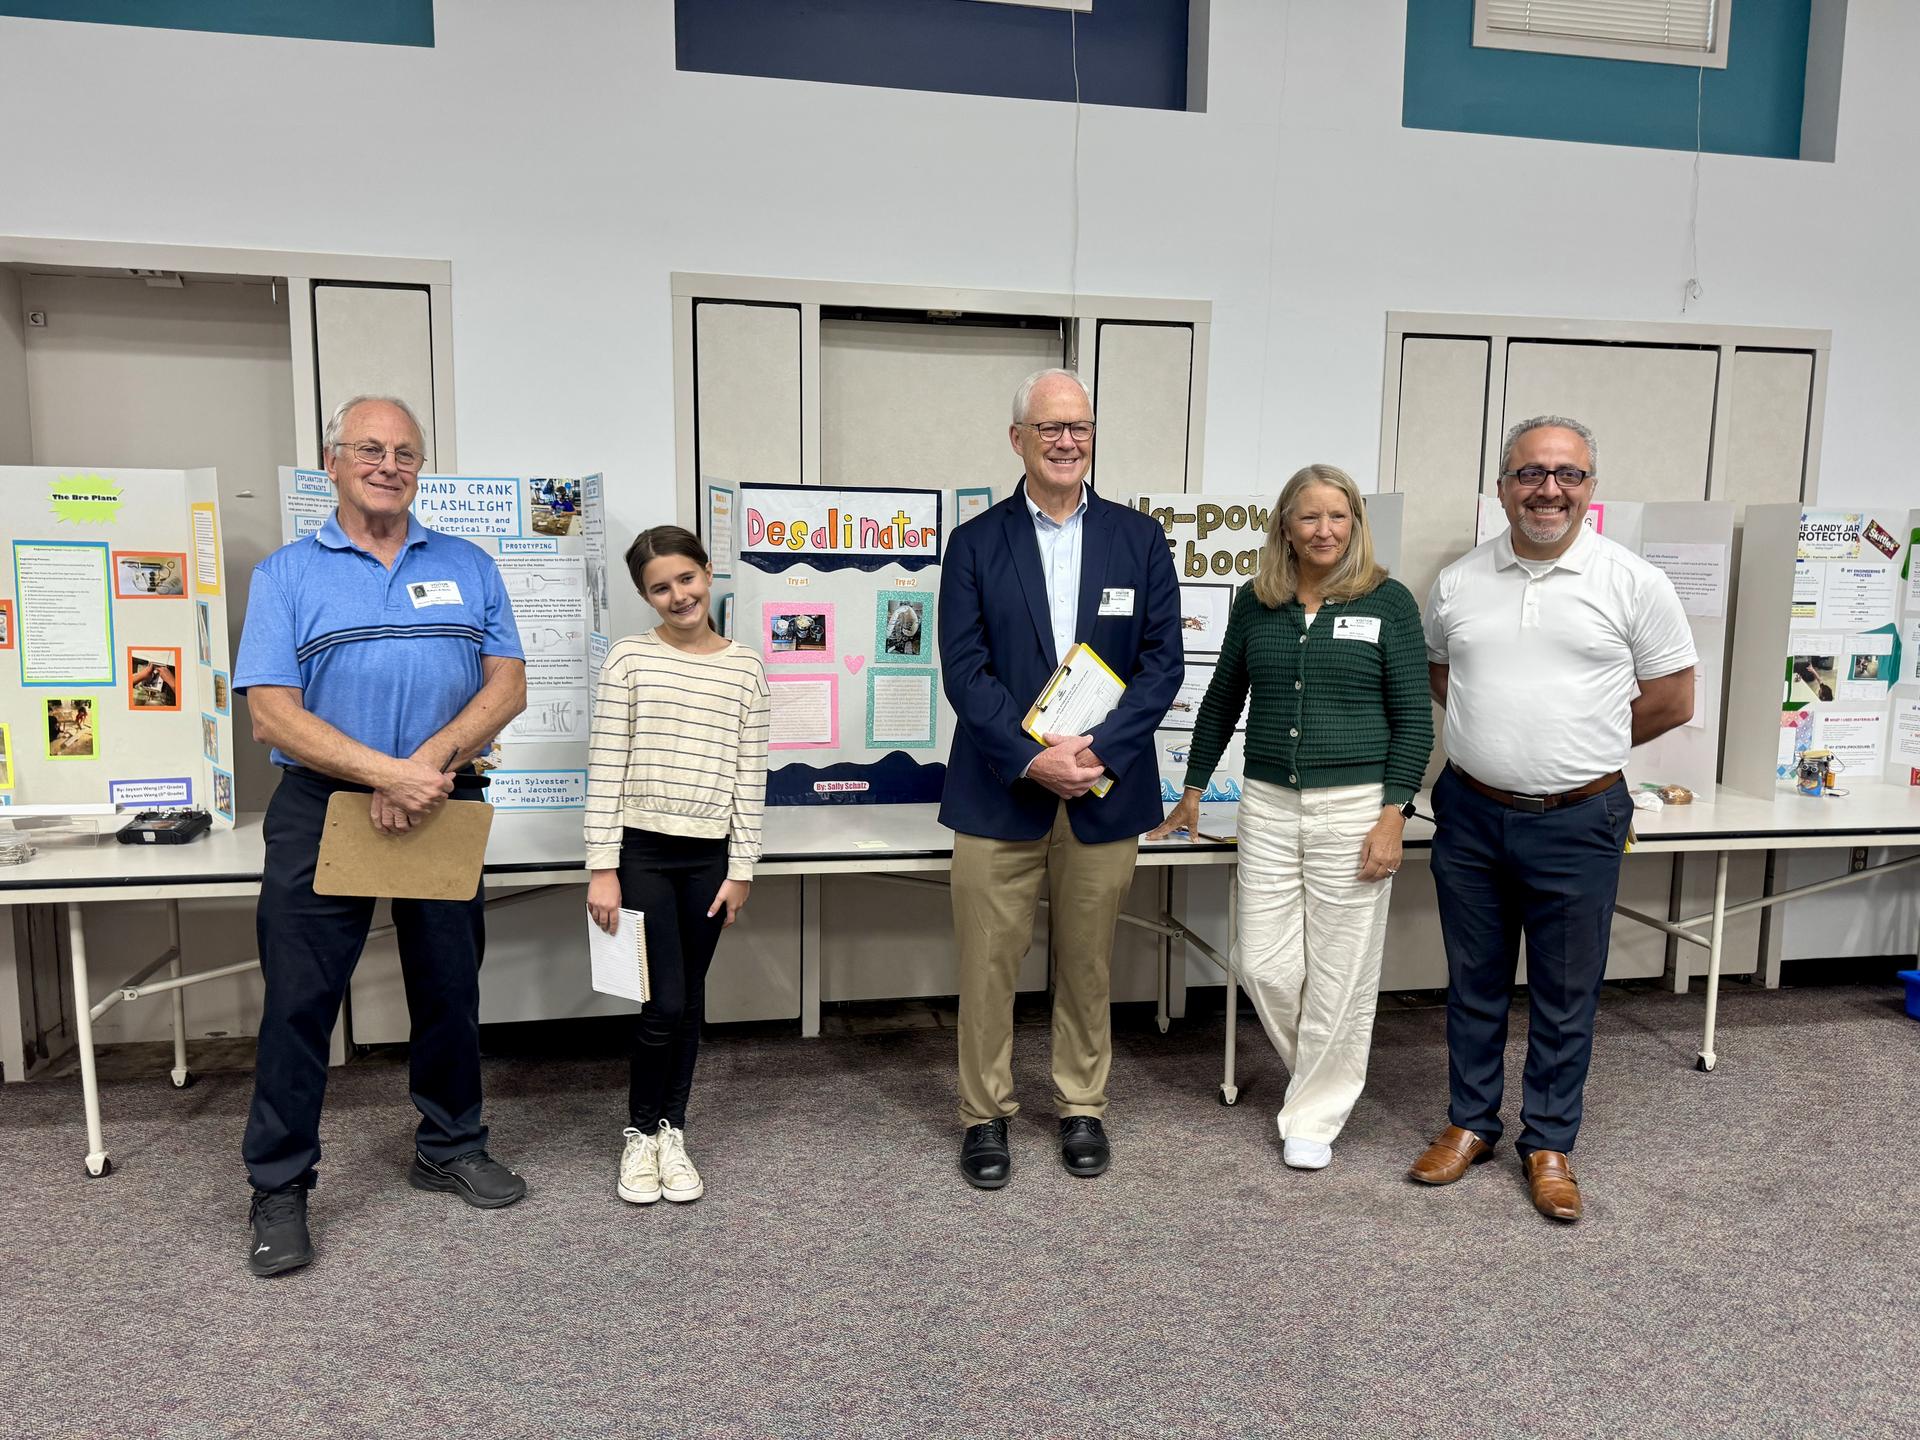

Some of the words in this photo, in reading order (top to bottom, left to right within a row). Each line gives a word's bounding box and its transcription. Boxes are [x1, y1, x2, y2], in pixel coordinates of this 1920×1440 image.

[420, 483, 456, 494] HAND
[468, 484, 512, 495] CRANK
[421, 500, 512, 512] FLASHLIGHT
[439, 516, 490, 524] Components
[747, 508, 936, 550] Desalinator
[1810, 524, 1842, 532] CANDY
[1798, 532, 1858, 542] ROTECTOR
[1868, 528, 1895, 552] Skittles
[1184, 540, 1266, 578] boa
[525, 778, 570, 786] Sylvester
